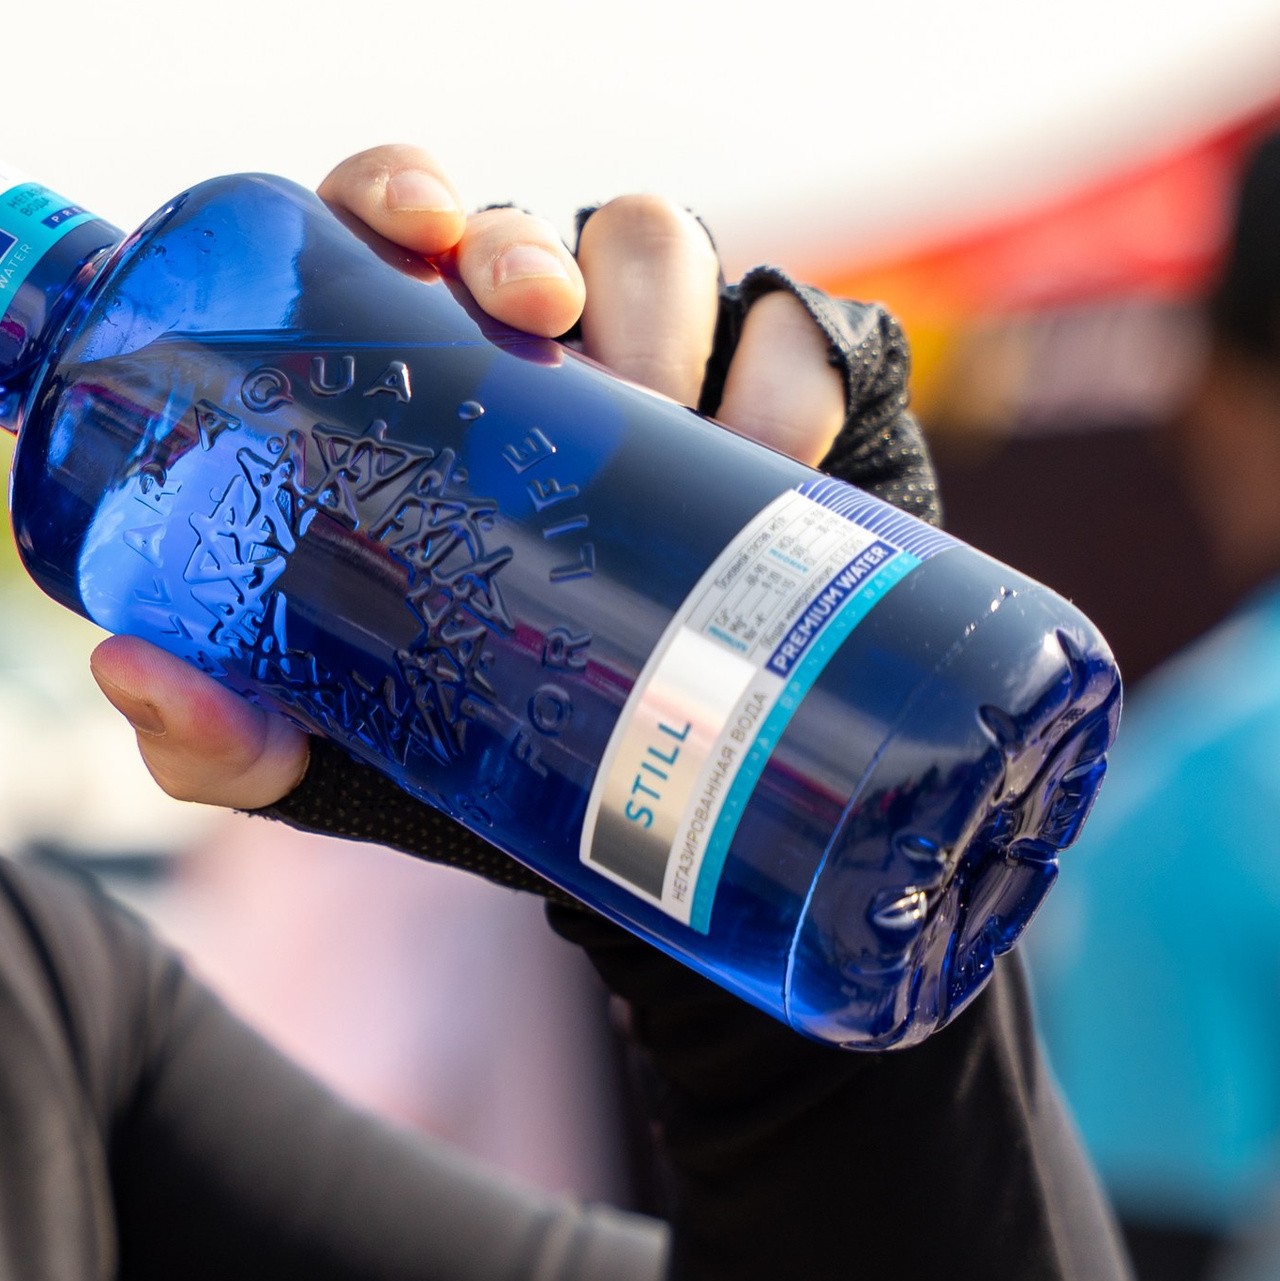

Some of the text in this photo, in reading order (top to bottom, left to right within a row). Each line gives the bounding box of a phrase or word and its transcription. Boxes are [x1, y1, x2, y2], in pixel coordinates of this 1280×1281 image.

[194, 354, 412, 452] AQUA
[771, 587, 843, 673] PREMIUM
[839, 544, 889, 598] WATER
[625, 720, 692, 829] STILL
[670, 746, 736, 902] НЕГАЗИРОВАННАЯ
[729, 691, 769, 744] ВОДА
